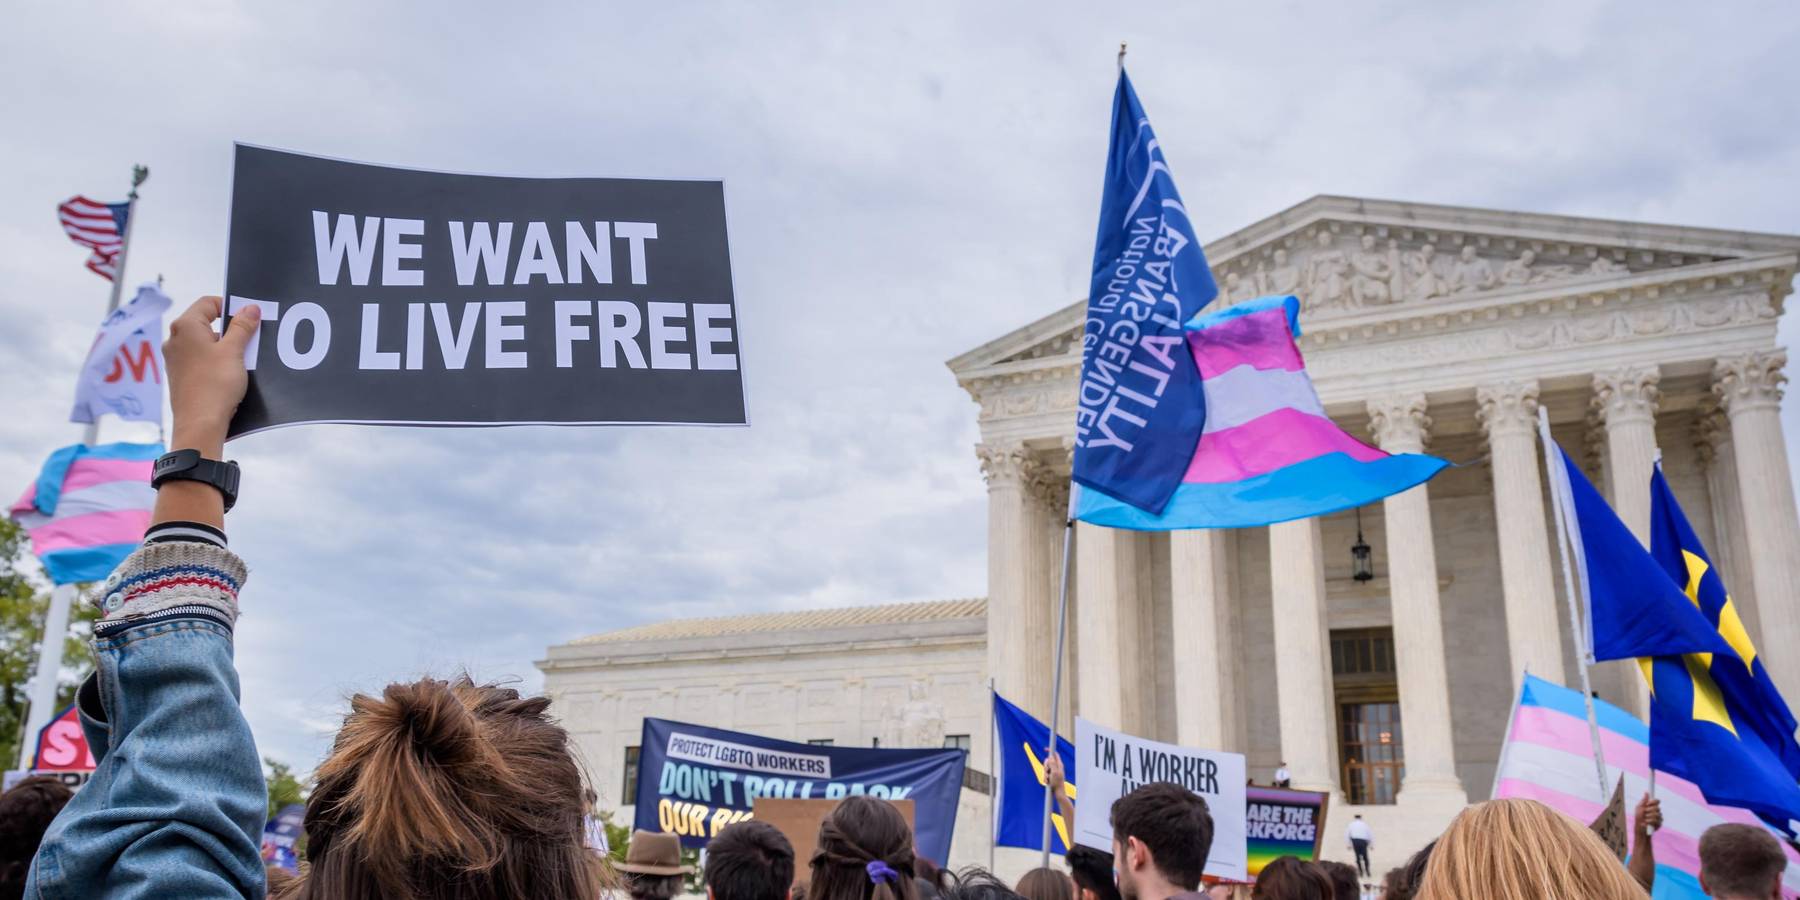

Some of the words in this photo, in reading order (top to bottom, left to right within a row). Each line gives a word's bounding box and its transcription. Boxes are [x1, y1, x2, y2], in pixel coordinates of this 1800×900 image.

[312, 210, 425, 286] WE
[448, 221, 658, 286] WANT
[229, 295, 331, 370] TO
[358, 301, 528, 370] LIVE
[554, 300, 738, 371] FREE
[672, 738, 715, 757] PROTECT
[715, 745, 754, 768] LGBTQ
[757, 752, 825, 774] WORKERS
[1095, 733, 1117, 774] I'M
[1122, 743, 1132, 779] A
[1139, 747, 1219, 794] WORKER
[659, 761, 738, 806] DON'T
[659, 798, 709, 838] OUR
[1248, 803, 1282, 823] ARE
[1283, 806, 1313, 825] THE
